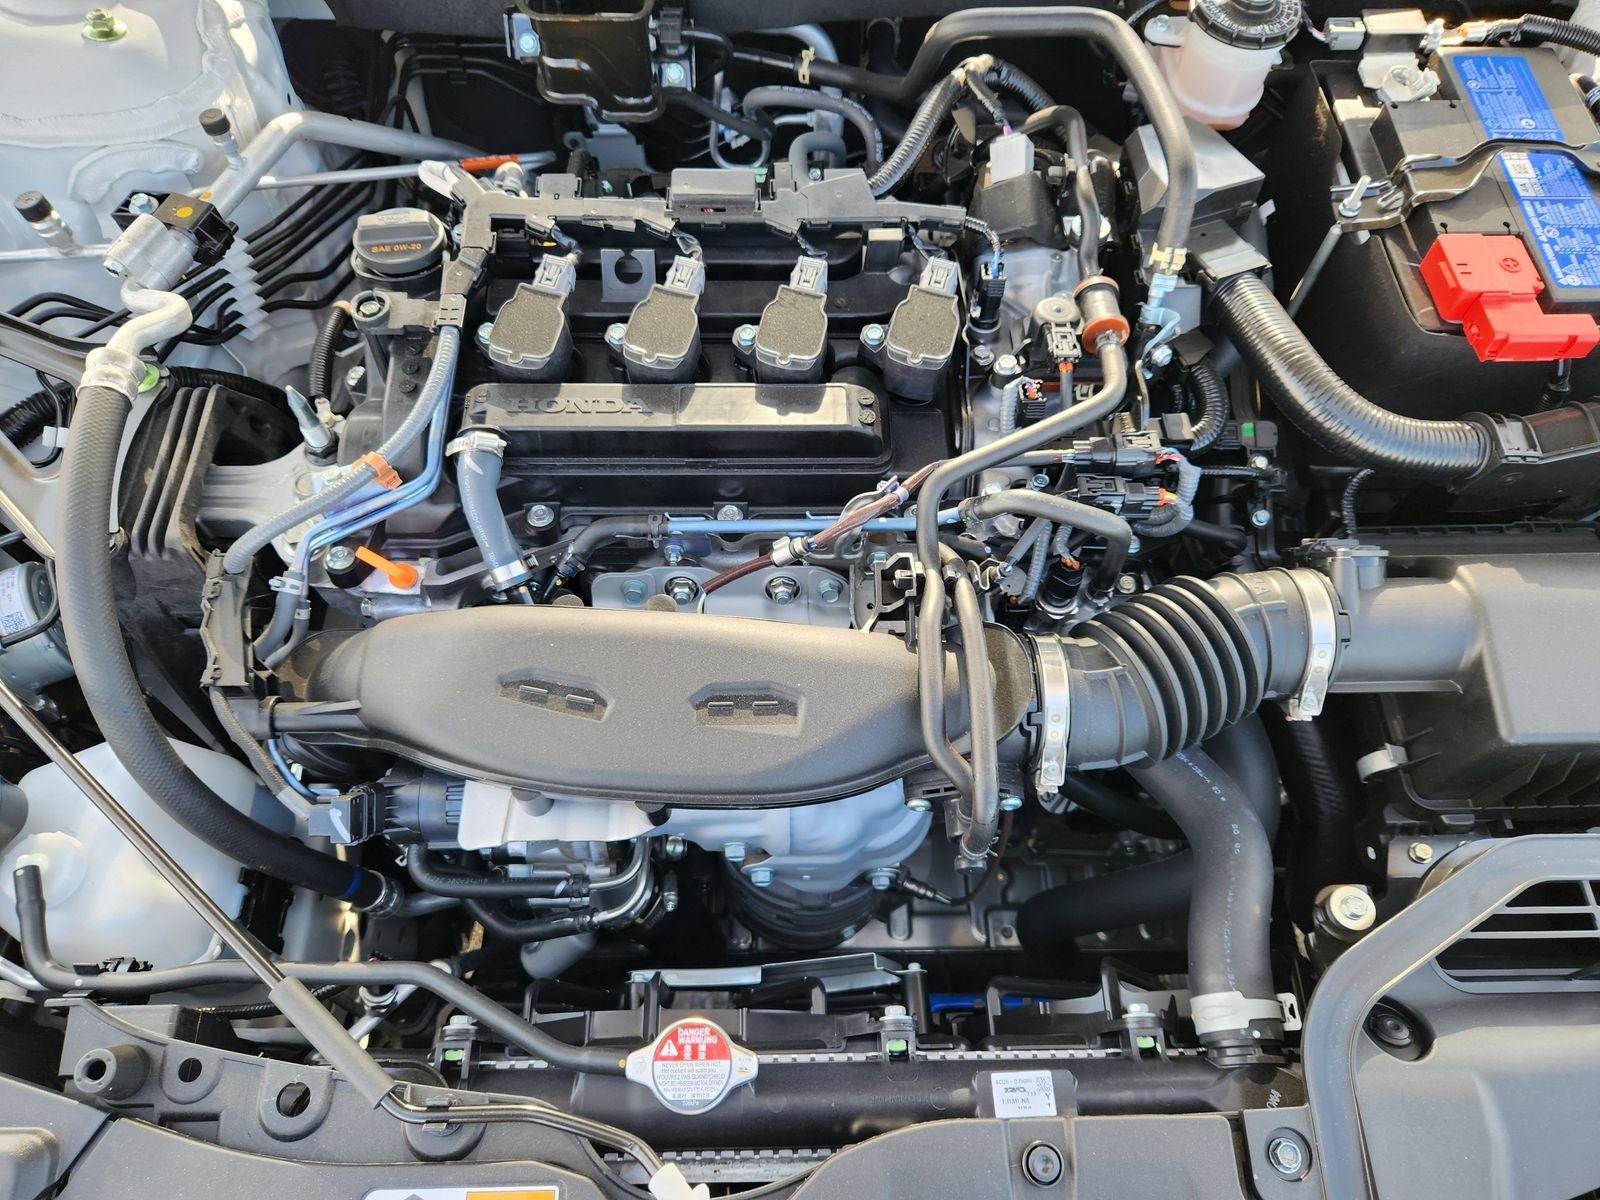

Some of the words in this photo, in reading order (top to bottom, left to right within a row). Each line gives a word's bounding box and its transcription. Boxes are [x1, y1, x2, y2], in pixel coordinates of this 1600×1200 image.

[371, 245, 391, 253] SAE
[393, 242, 422, 252] 0W-20
[506, 398, 653, 415] HONDA
[678, 1028, 710, 1036] DANGER
[678, 1035, 718, 1044] WARNUNG
